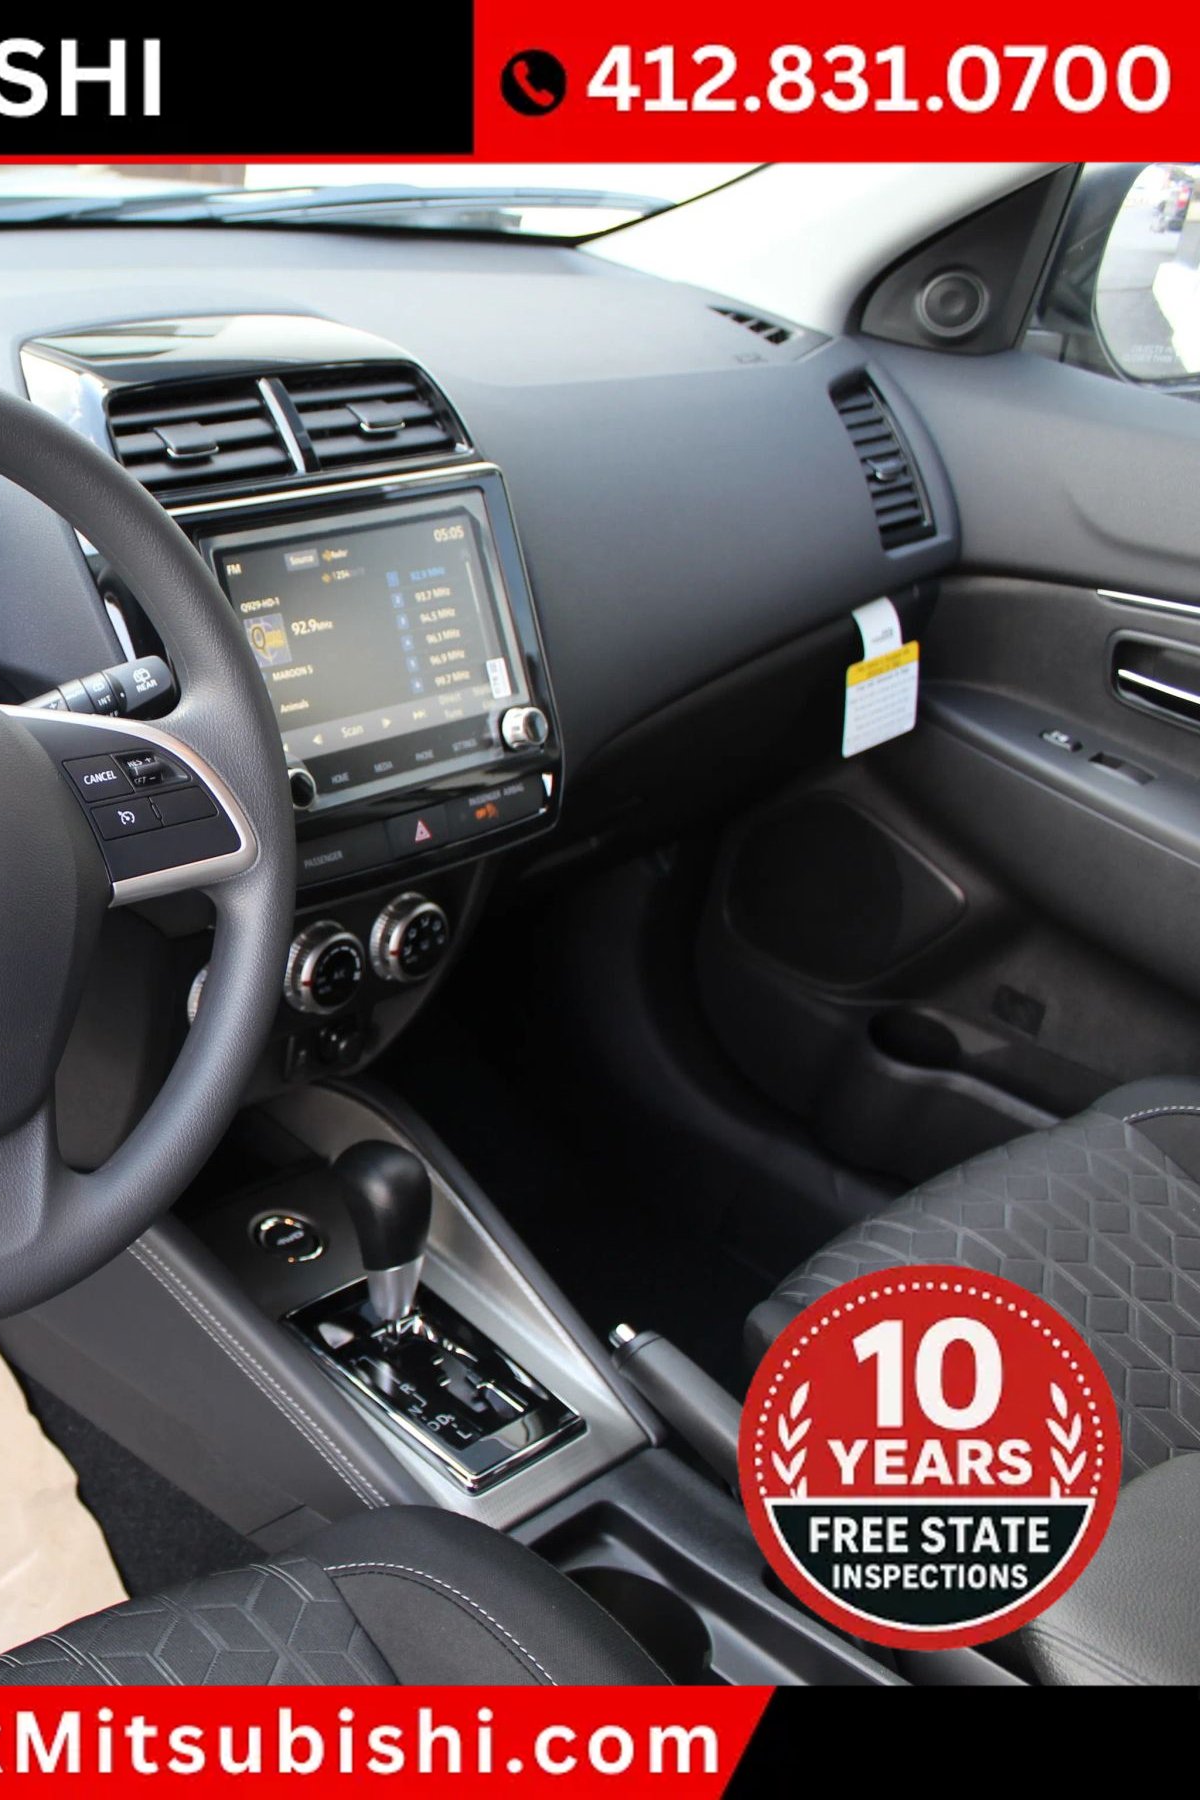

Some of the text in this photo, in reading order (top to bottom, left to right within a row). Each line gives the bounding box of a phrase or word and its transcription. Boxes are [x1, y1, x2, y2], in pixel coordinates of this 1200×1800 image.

[433, 525, 464, 542] 05:05
[227, 564, 242, 576] FM
[135, 679, 158, 693] REAR
[98, 694, 112, 706] INT
[341, 725, 364, 739] Scan
[83, 770, 117, 785] CANCEL
[331, 772, 350, 785] HOME
[304, 851, 344, 868] PASSENGER
[399, 1383, 417, 1395] R
[456, 1429, 473, 1440] L
